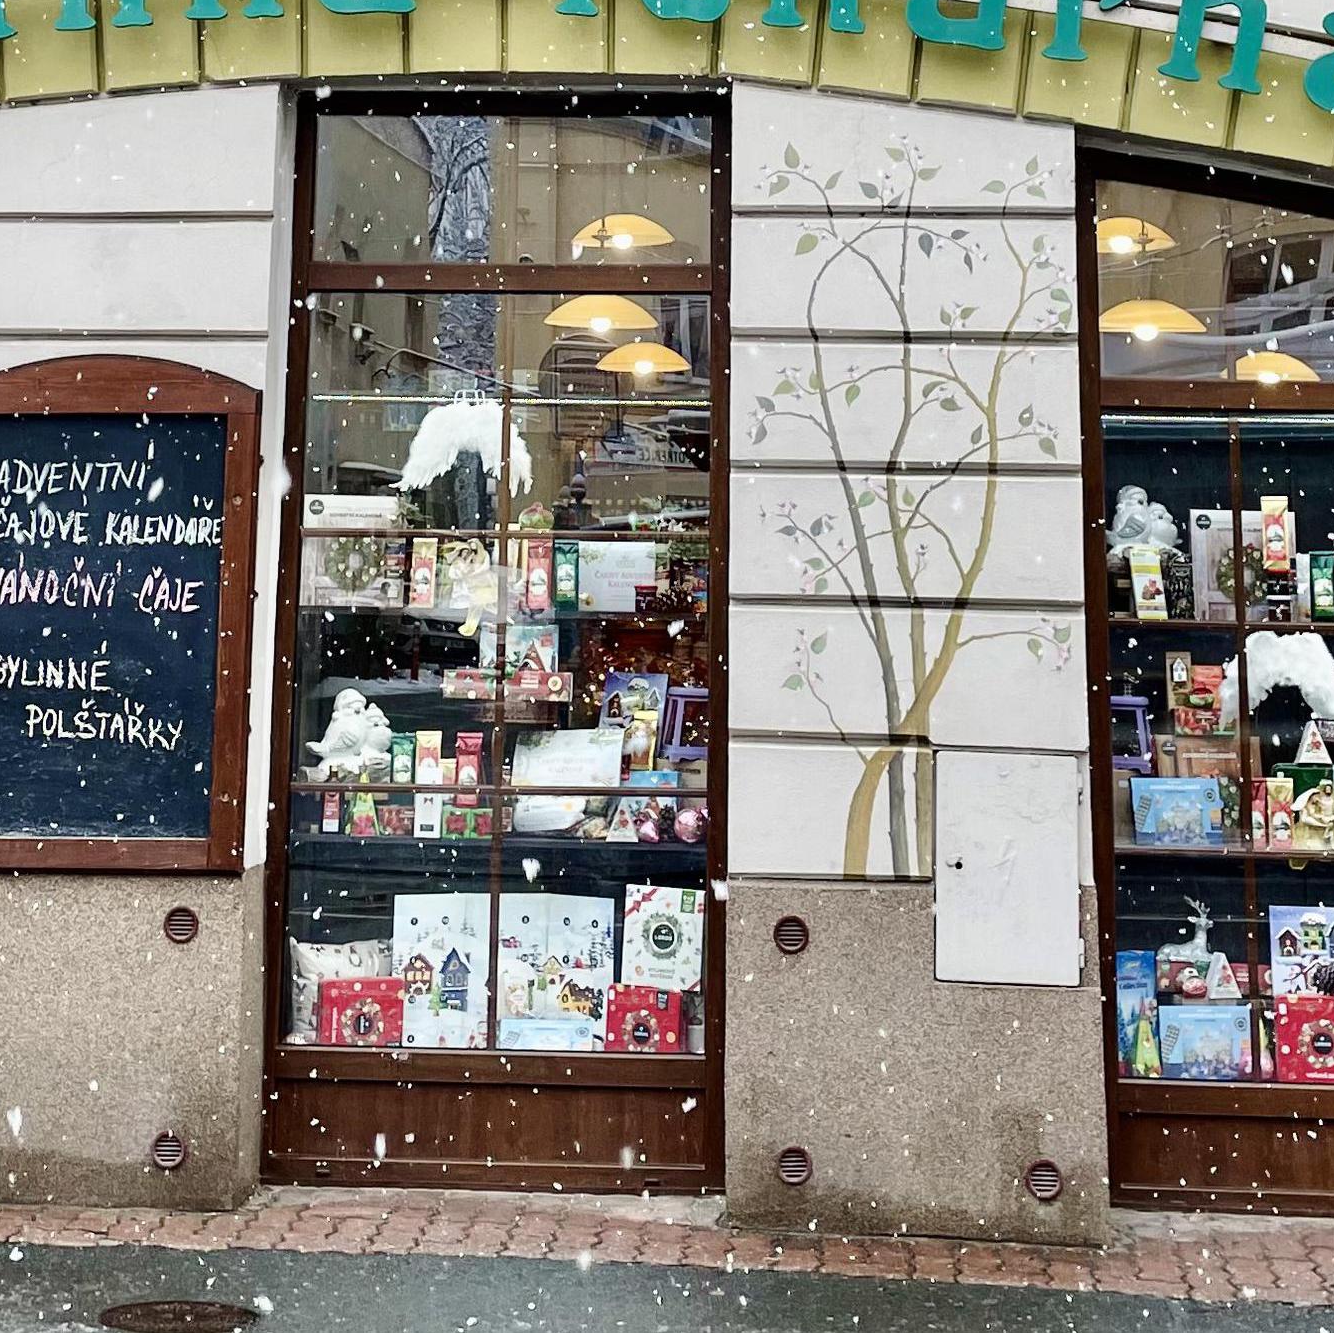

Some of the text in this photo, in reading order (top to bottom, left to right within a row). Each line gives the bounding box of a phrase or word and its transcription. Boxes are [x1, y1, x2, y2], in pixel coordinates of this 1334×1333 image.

[104, 494, 223, 547] KALENDÁŘE
[138, 566, 205, 615] ČAJE
[25, 697, 184, 752] POLŠTÁŘKY
